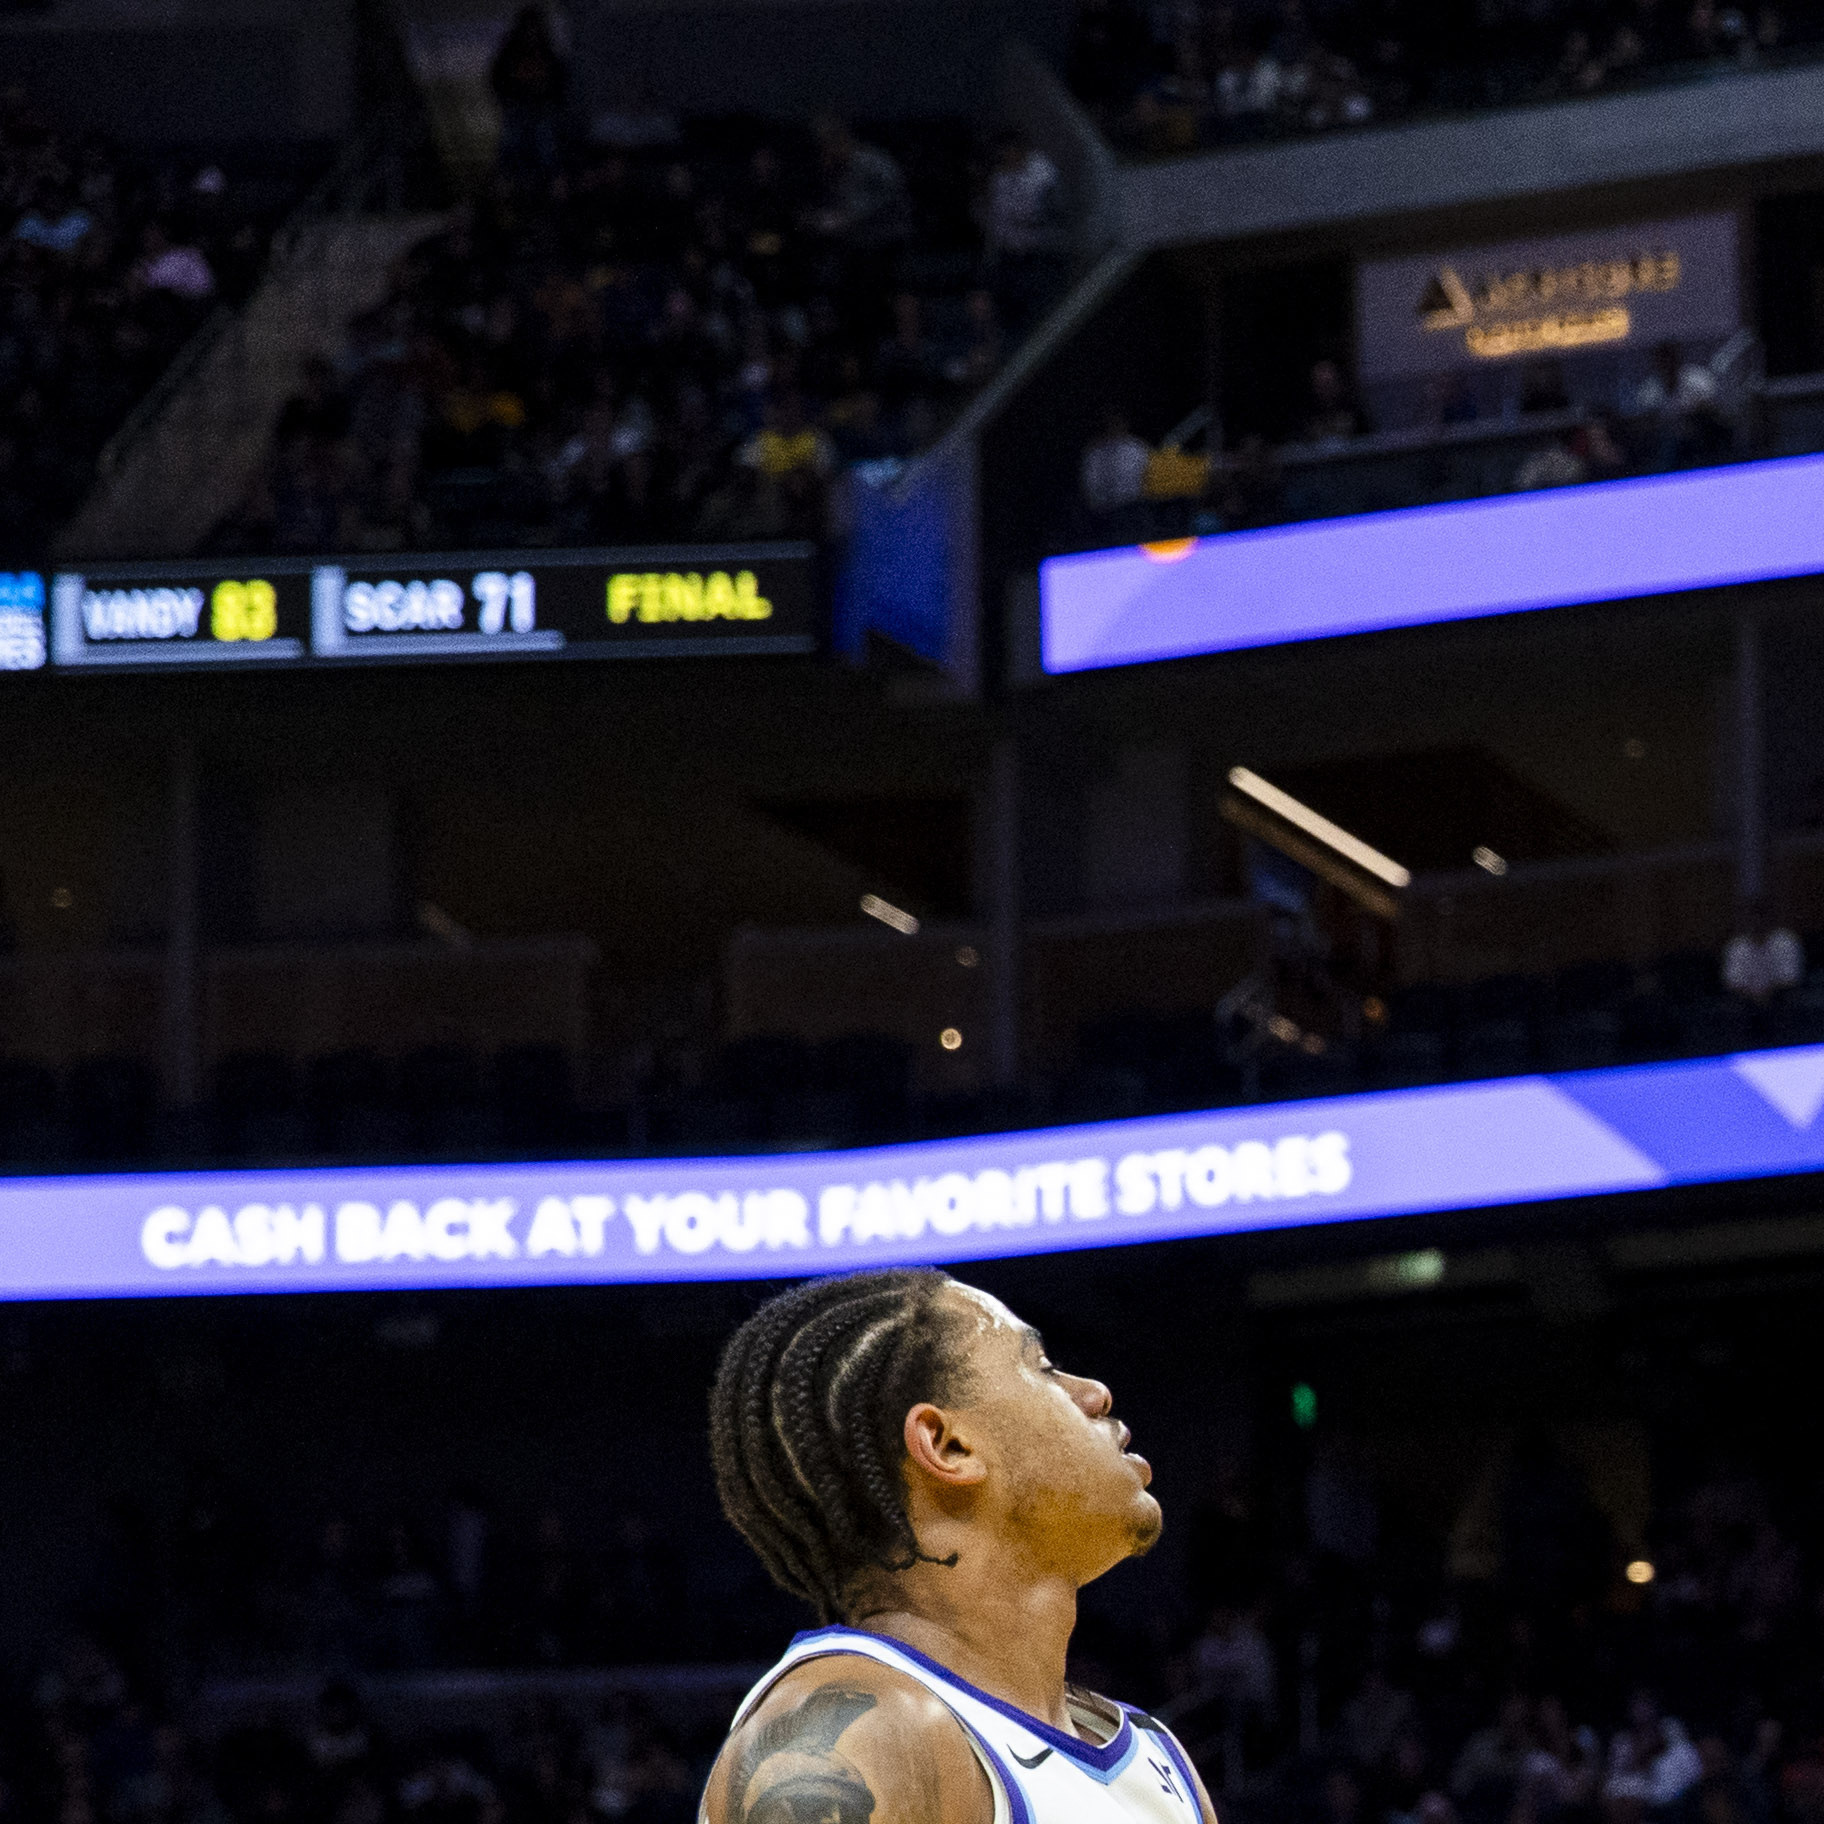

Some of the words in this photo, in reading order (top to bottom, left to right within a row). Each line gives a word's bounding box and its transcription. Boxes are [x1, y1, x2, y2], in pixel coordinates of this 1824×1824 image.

[472, 571, 536, 634] 71
[607, 570, 773, 624] FINAL
[141, 1203, 325, 1270] CASH
[335, 1197, 517, 1263] BACK
[526, 1196, 615, 1258] AT
[622, 1187, 809, 1255] YOUR
[818, 1157, 1110, 1247] FAVORITE
[1114, 1130, 1353, 1214] STORES
